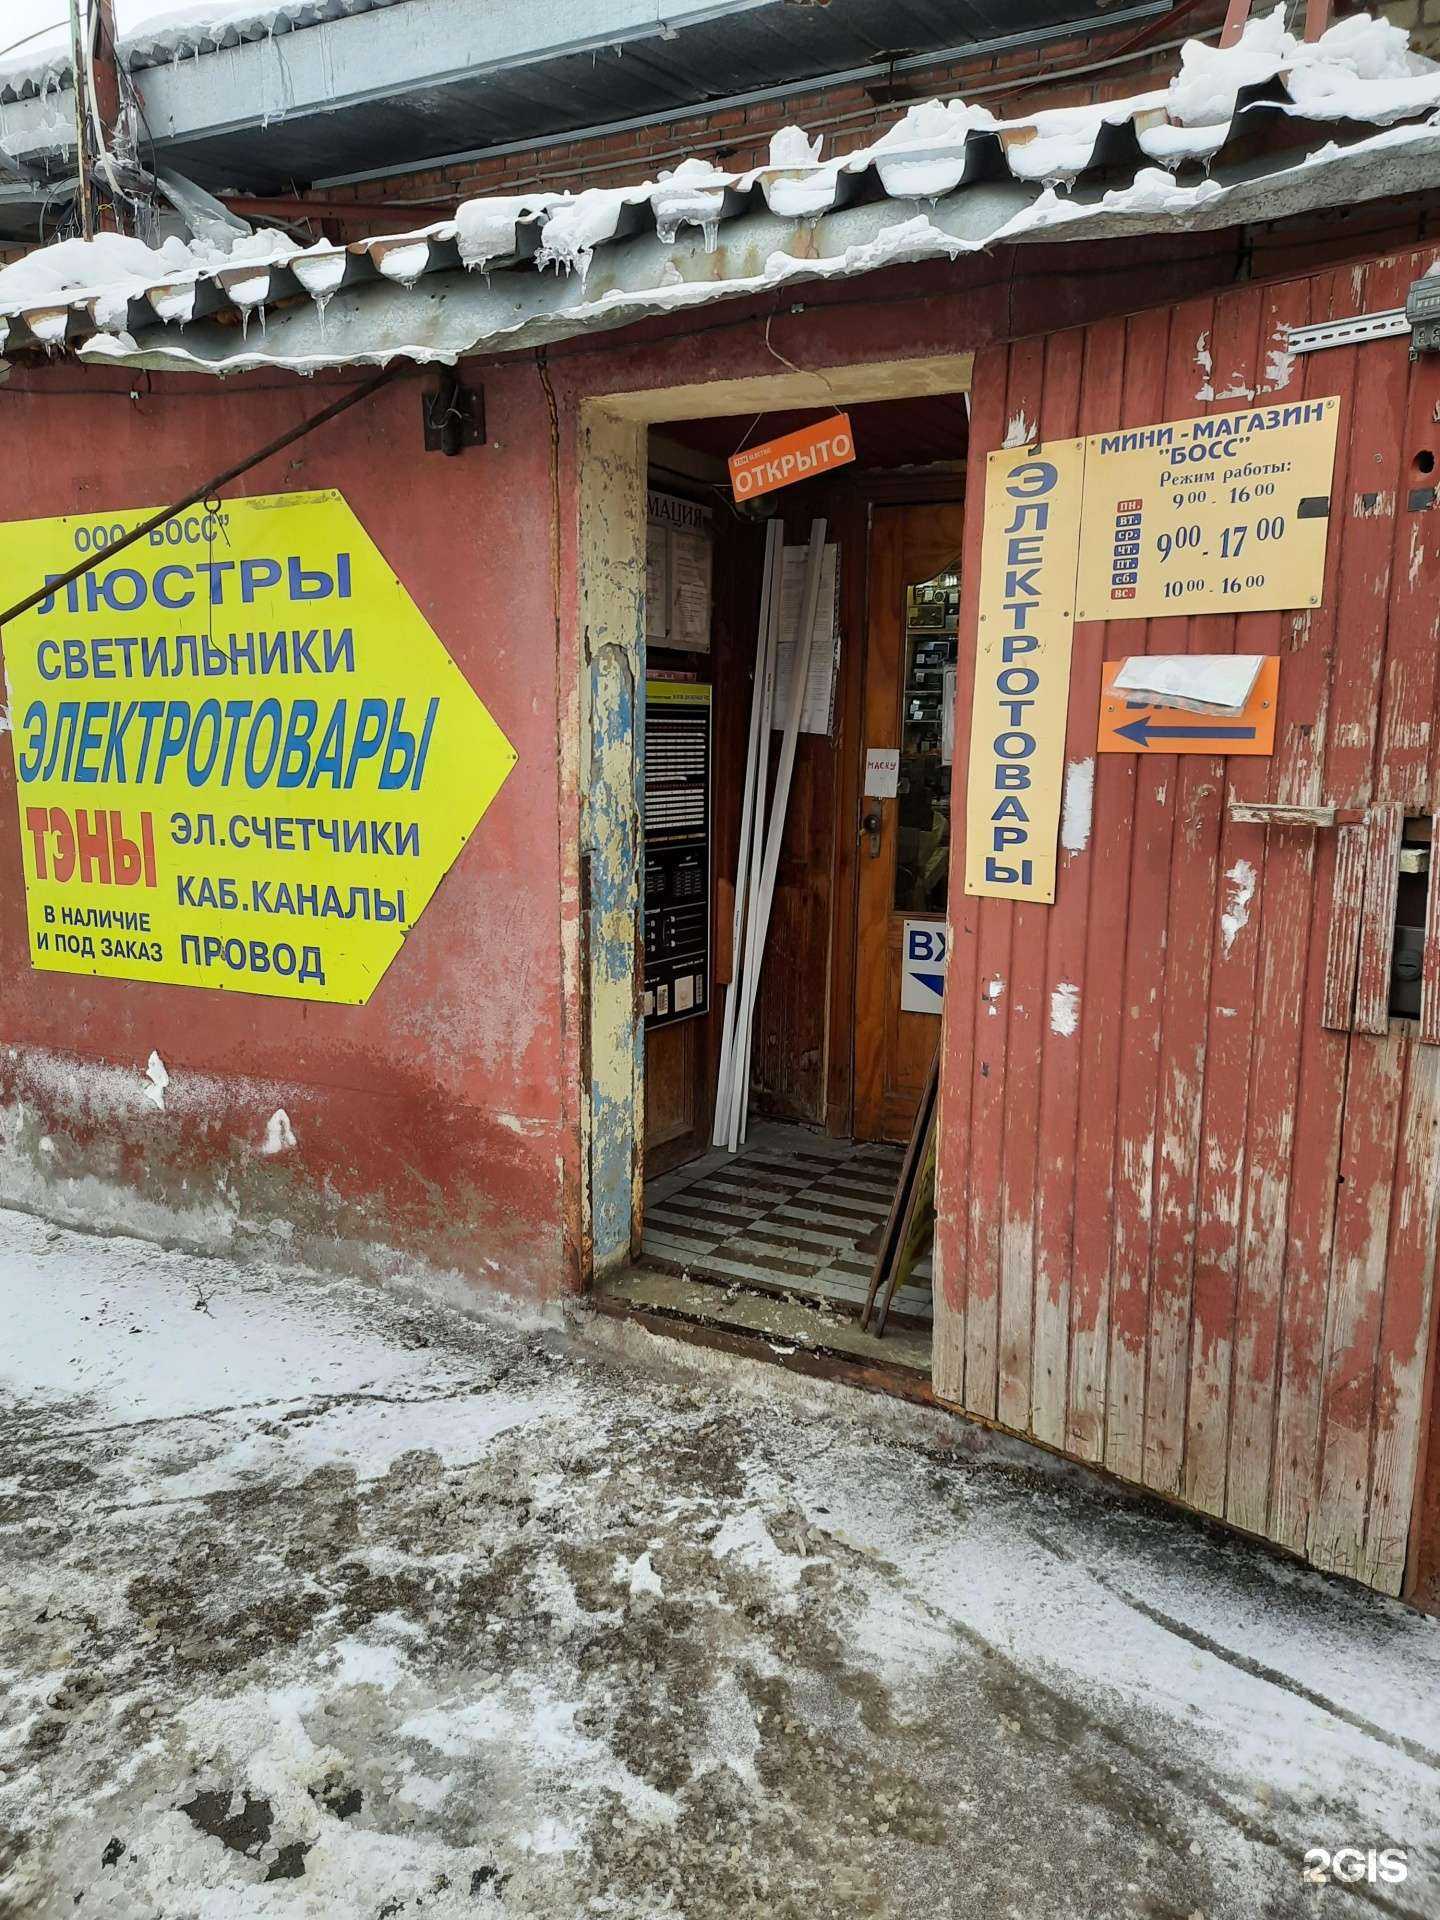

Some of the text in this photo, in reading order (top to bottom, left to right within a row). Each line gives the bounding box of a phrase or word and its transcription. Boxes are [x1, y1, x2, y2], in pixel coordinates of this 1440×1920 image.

[735, 433, 851, 493] ОТКРЫТО
[1159, 460, 1293, 488] Режим работы:
[74, 524, 126, 552] ООО
[37, 553, 352, 615] ЛЮСТРЫ
[37, 629, 355, 680] СВЕТИЛЬНИКИ
[985, 461, 1058, 886] ЭЛЕКТРОТОВАРЫ
[19, 697, 440, 791] ЭЛЕКТРОТОВАРЫ
[26, 807, 158, 888] ТЭНЫ
[45, 905, 151, 933] В НАЛИЧИЕ
[37, 932, 163, 963] И ПОД ЗАКАЗ
[181, 935, 325, 985] ПРОВОД
